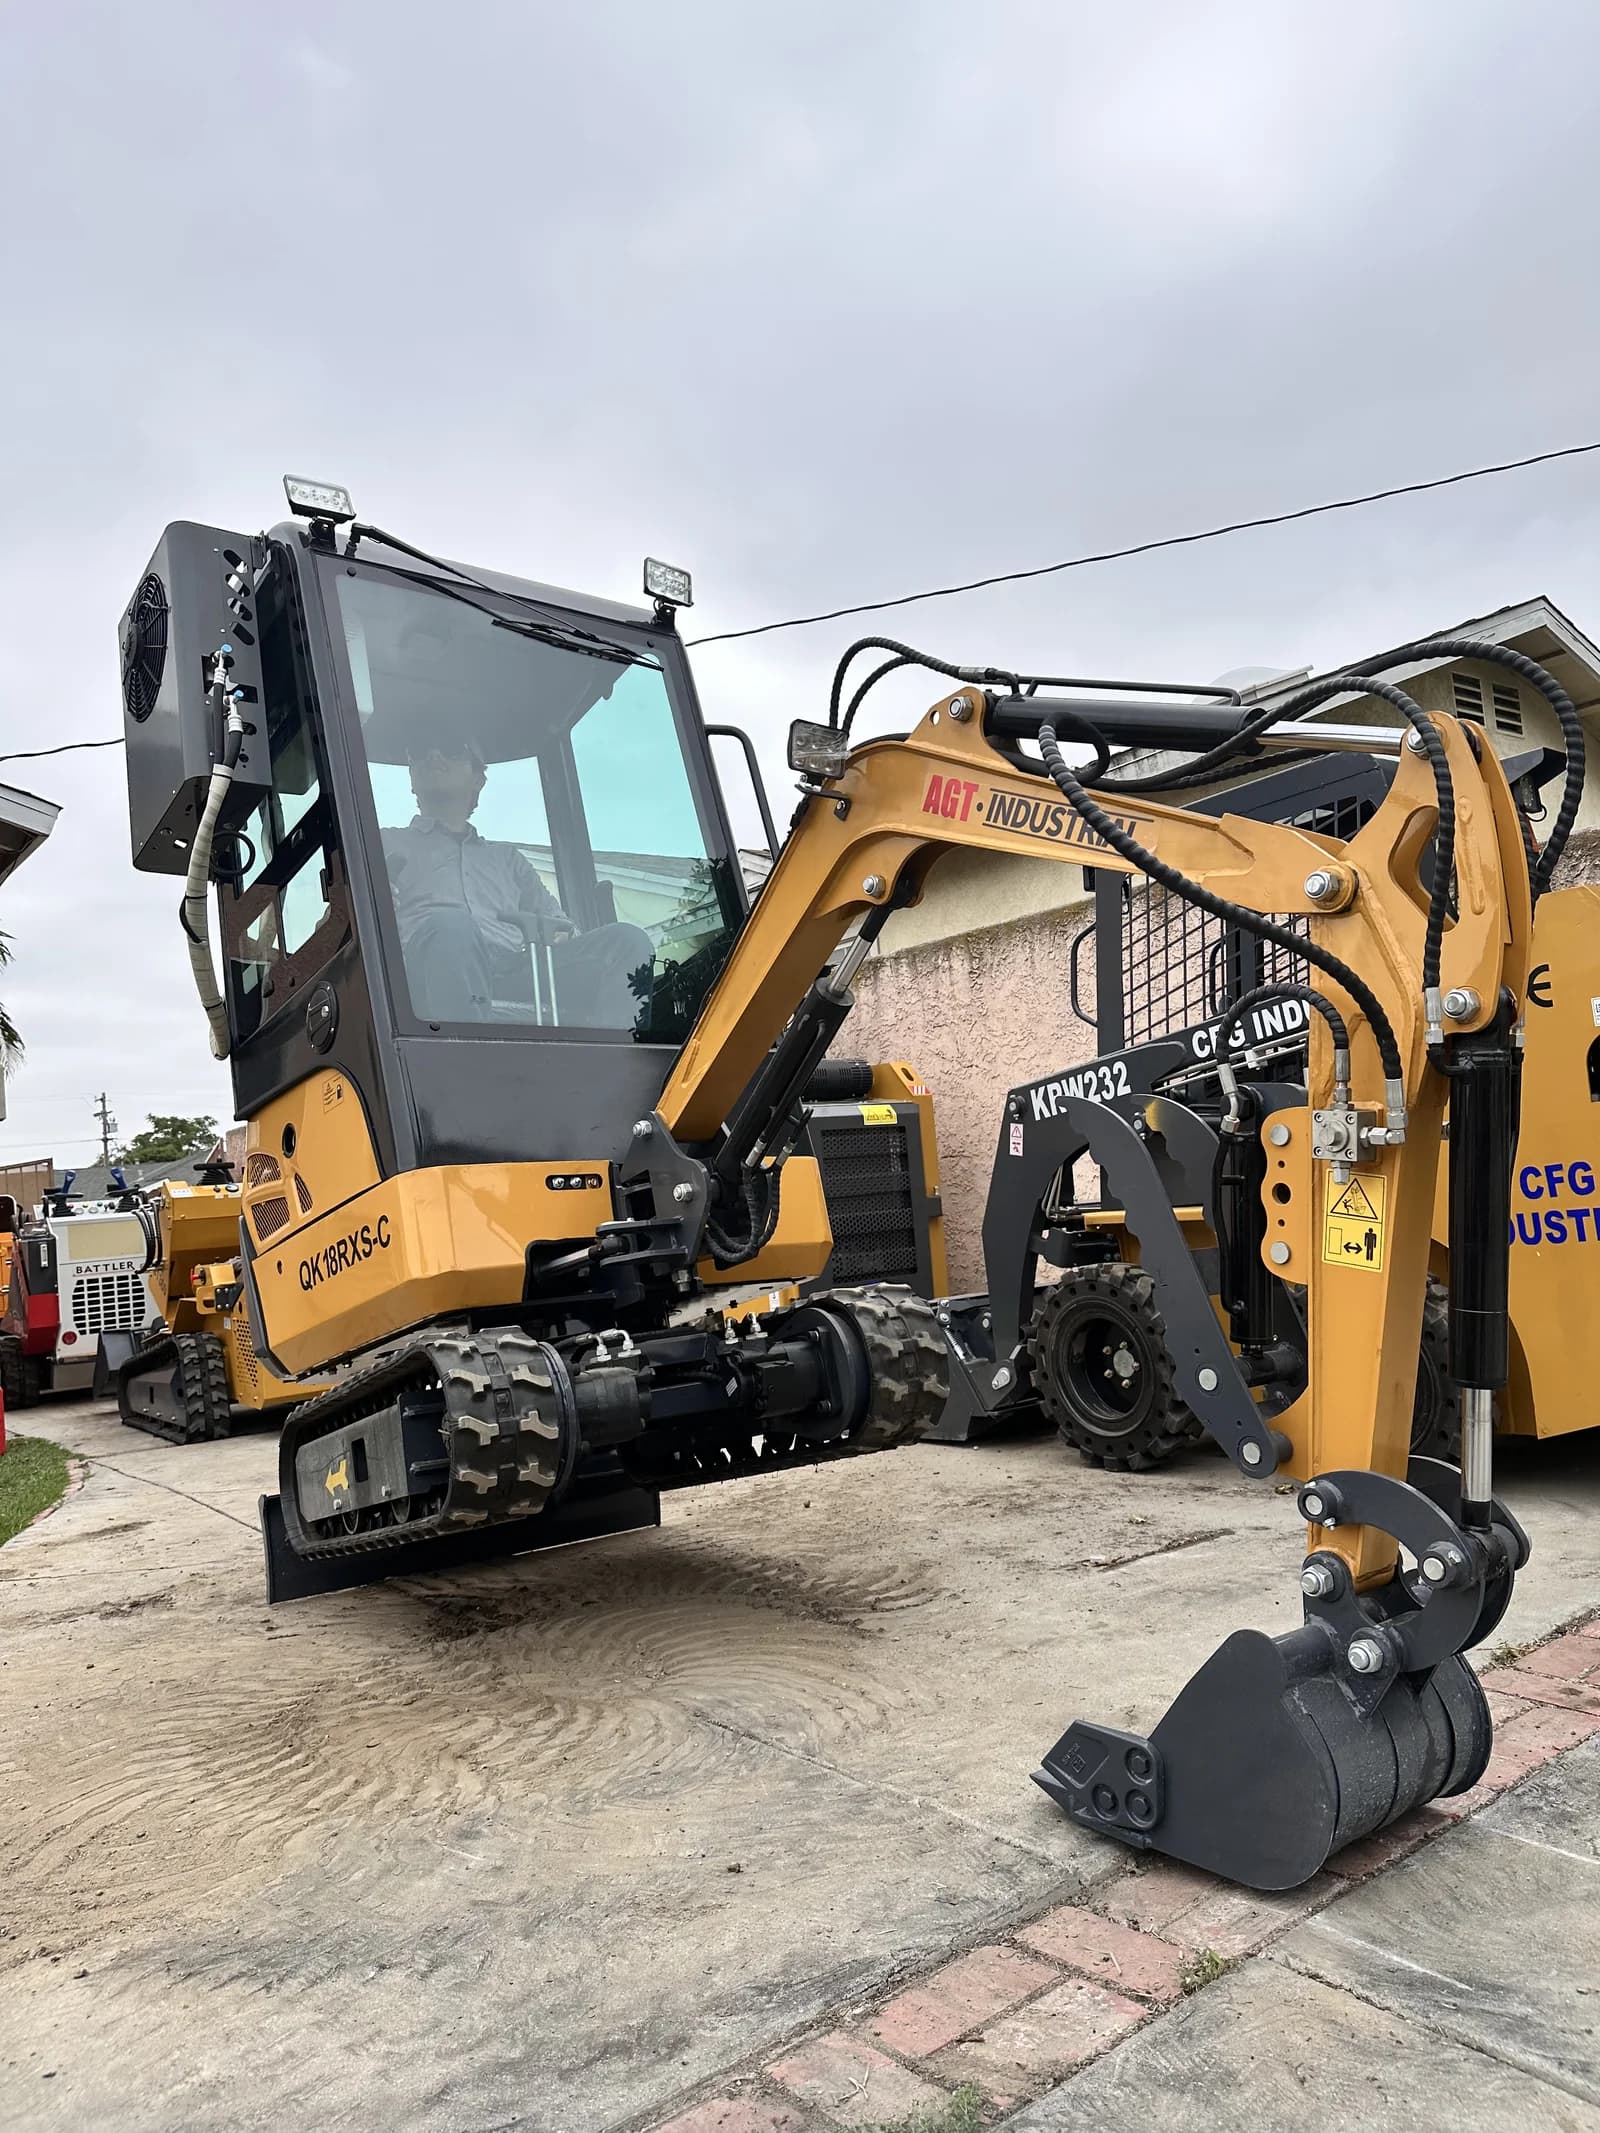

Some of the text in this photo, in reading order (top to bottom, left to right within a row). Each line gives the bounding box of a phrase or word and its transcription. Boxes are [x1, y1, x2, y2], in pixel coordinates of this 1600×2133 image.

[922, 774, 979, 822] AGT
[1519, 1161, 1596, 1200] CFG
[1509, 1207, 1600, 1246] UST
[75, 1261, 135, 1274] BATTLER
